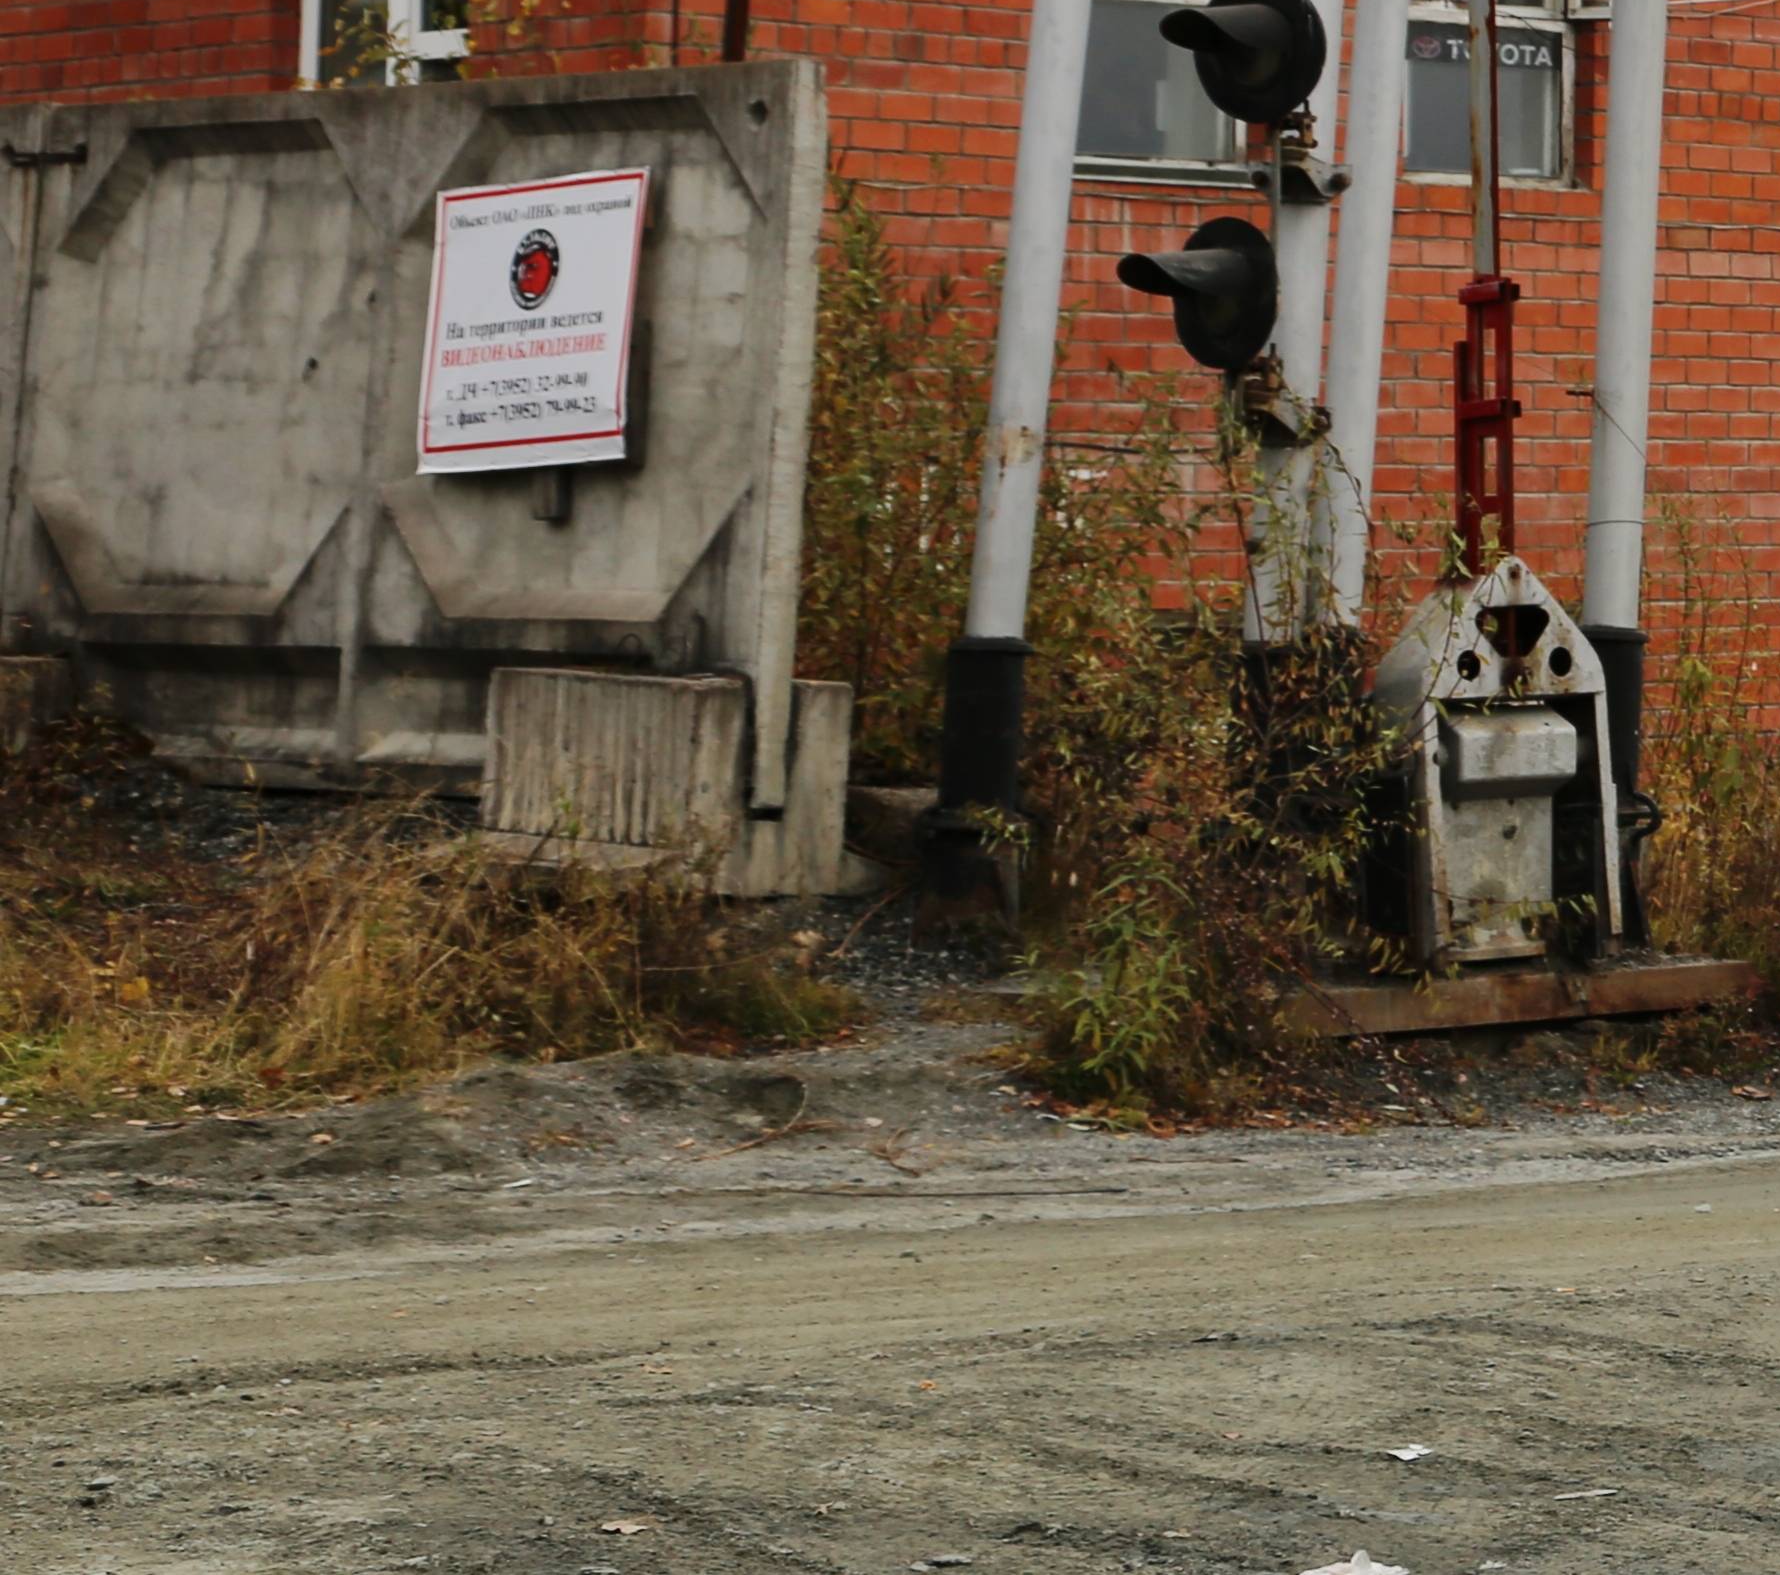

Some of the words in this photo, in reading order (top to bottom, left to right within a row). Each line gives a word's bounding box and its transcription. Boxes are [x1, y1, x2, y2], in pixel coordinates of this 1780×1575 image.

[1446, 39, 1553, 66] TOTA
[445, 322, 464, 339] На
[470, 317, 546, 340] территории
[441, 333, 607, 367] ВИДЕОНАБЛЮДЕНИЕ
